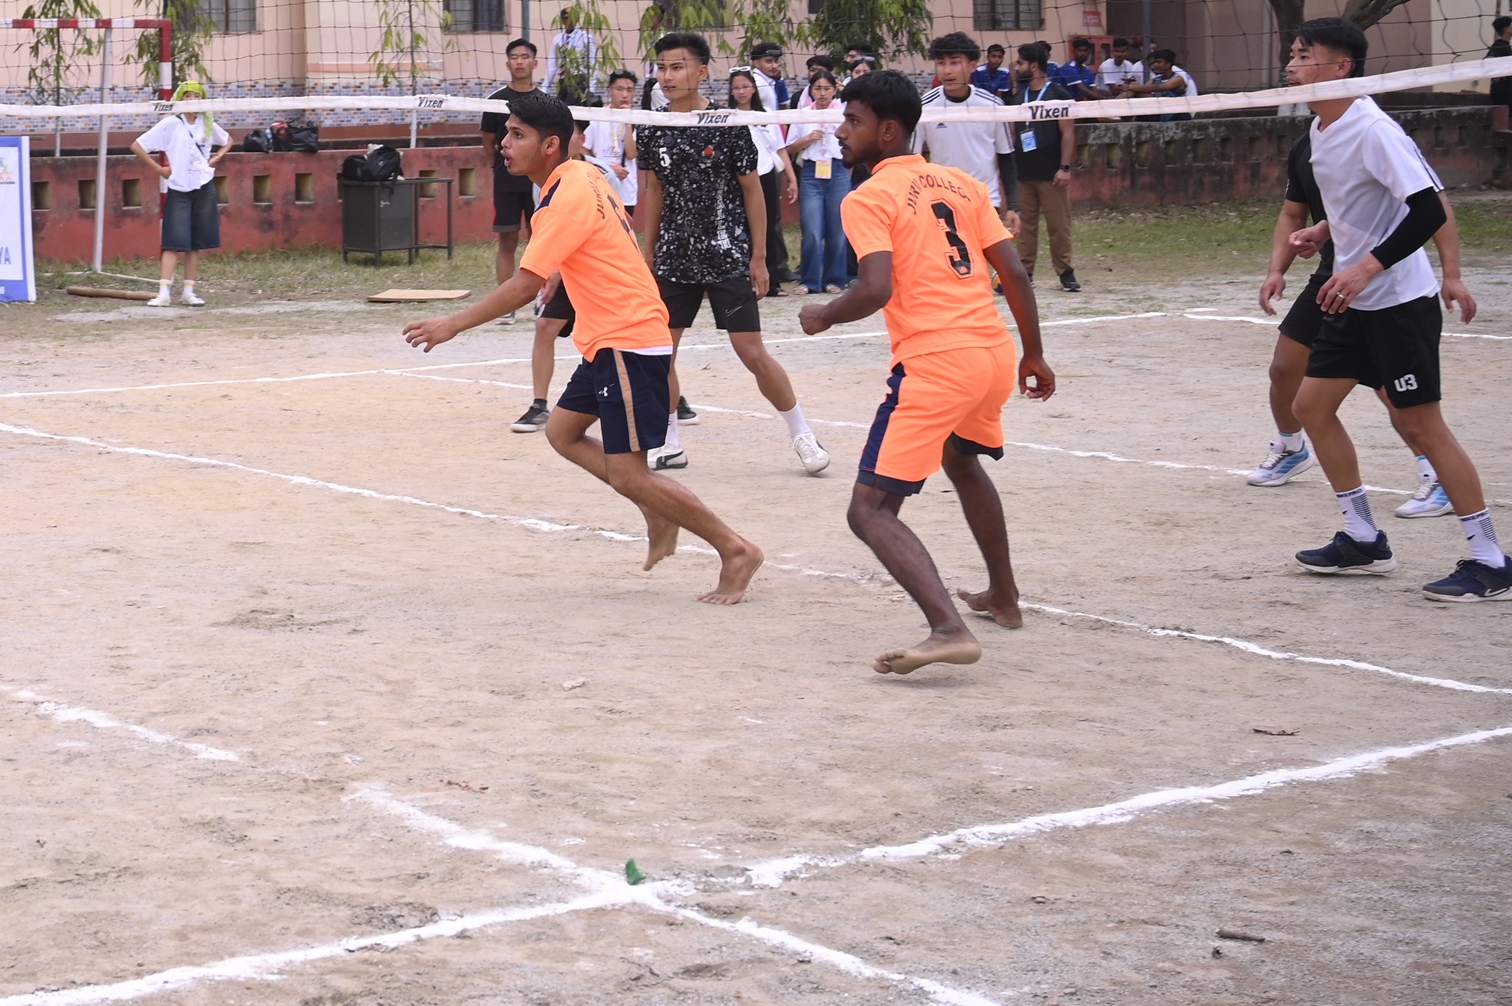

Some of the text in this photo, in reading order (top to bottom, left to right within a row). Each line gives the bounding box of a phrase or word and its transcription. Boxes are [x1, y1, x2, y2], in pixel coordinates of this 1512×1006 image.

[153, 102, 174, 112] Vixen
[417, 96, 445, 108] Vixen
[696, 113, 730, 125] Vixen
[1028, 105, 1070, 120] Vixen
[658, 146, 672, 168] 5
[930, 197, 975, 281] 3
